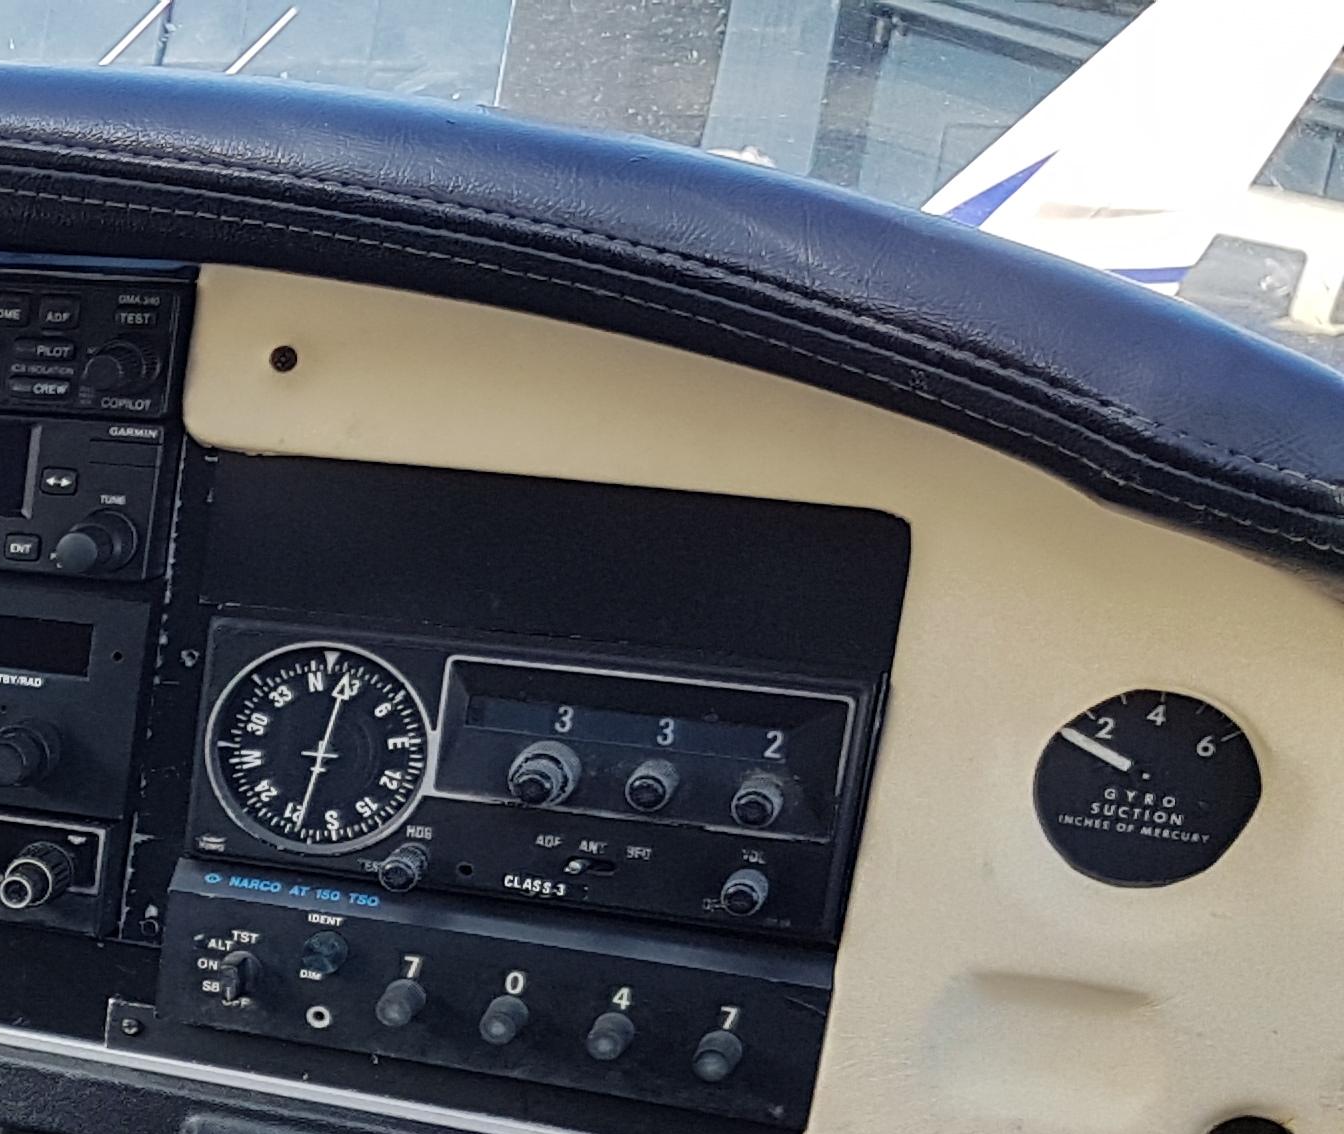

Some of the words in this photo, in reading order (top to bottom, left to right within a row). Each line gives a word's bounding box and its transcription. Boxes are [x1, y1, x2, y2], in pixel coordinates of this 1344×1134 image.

[120, 312, 150, 324] TEST
[109, 427, 159, 439] GARMIN
[308, 671, 324, 693] N
[269, 685, 292, 708] 33
[374, 702, 392, 718] 6
[554, 706, 574, 735] 3
[1147, 706, 1167, 728] 4
[246, 713, 269, 735] 30
[656, 718, 676, 747] 3
[1096, 718, 1116, 741] 2
[387, 737, 409, 750] E
[764, 730, 784, 759] 2
[1196, 736, 1217, 758] 6
[254, 779, 278, 801] 24
[379, 770, 402, 790] 12
[1104, 788, 1178, 809] GYRO
[324, 810, 340, 830] S
[1090, 802, 1185, 827] SUCTION
[1058, 813, 1110, 831] INCHES
[1140, 826, 1211, 844] MERCURY
[228, 876, 282, 893] NARCO
[288, 885, 310, 897] AT
[316, 889, 341, 901] 150
[348, 893, 381, 907] TSO
[504, 874, 567, 897] CLASS-3
[307, 913, 344, 926] IDENT
[207, 938, 233, 952] ALT
[231, 930, 260, 944] TST
[197, 957, 219, 971] ON
[403, 956, 422, 978] 7
[202, 980, 220, 993] SB
[504, 971, 525, 995] 0
[612, 987, 632, 1011] 4
[719, 1007, 739, 1029] 7
